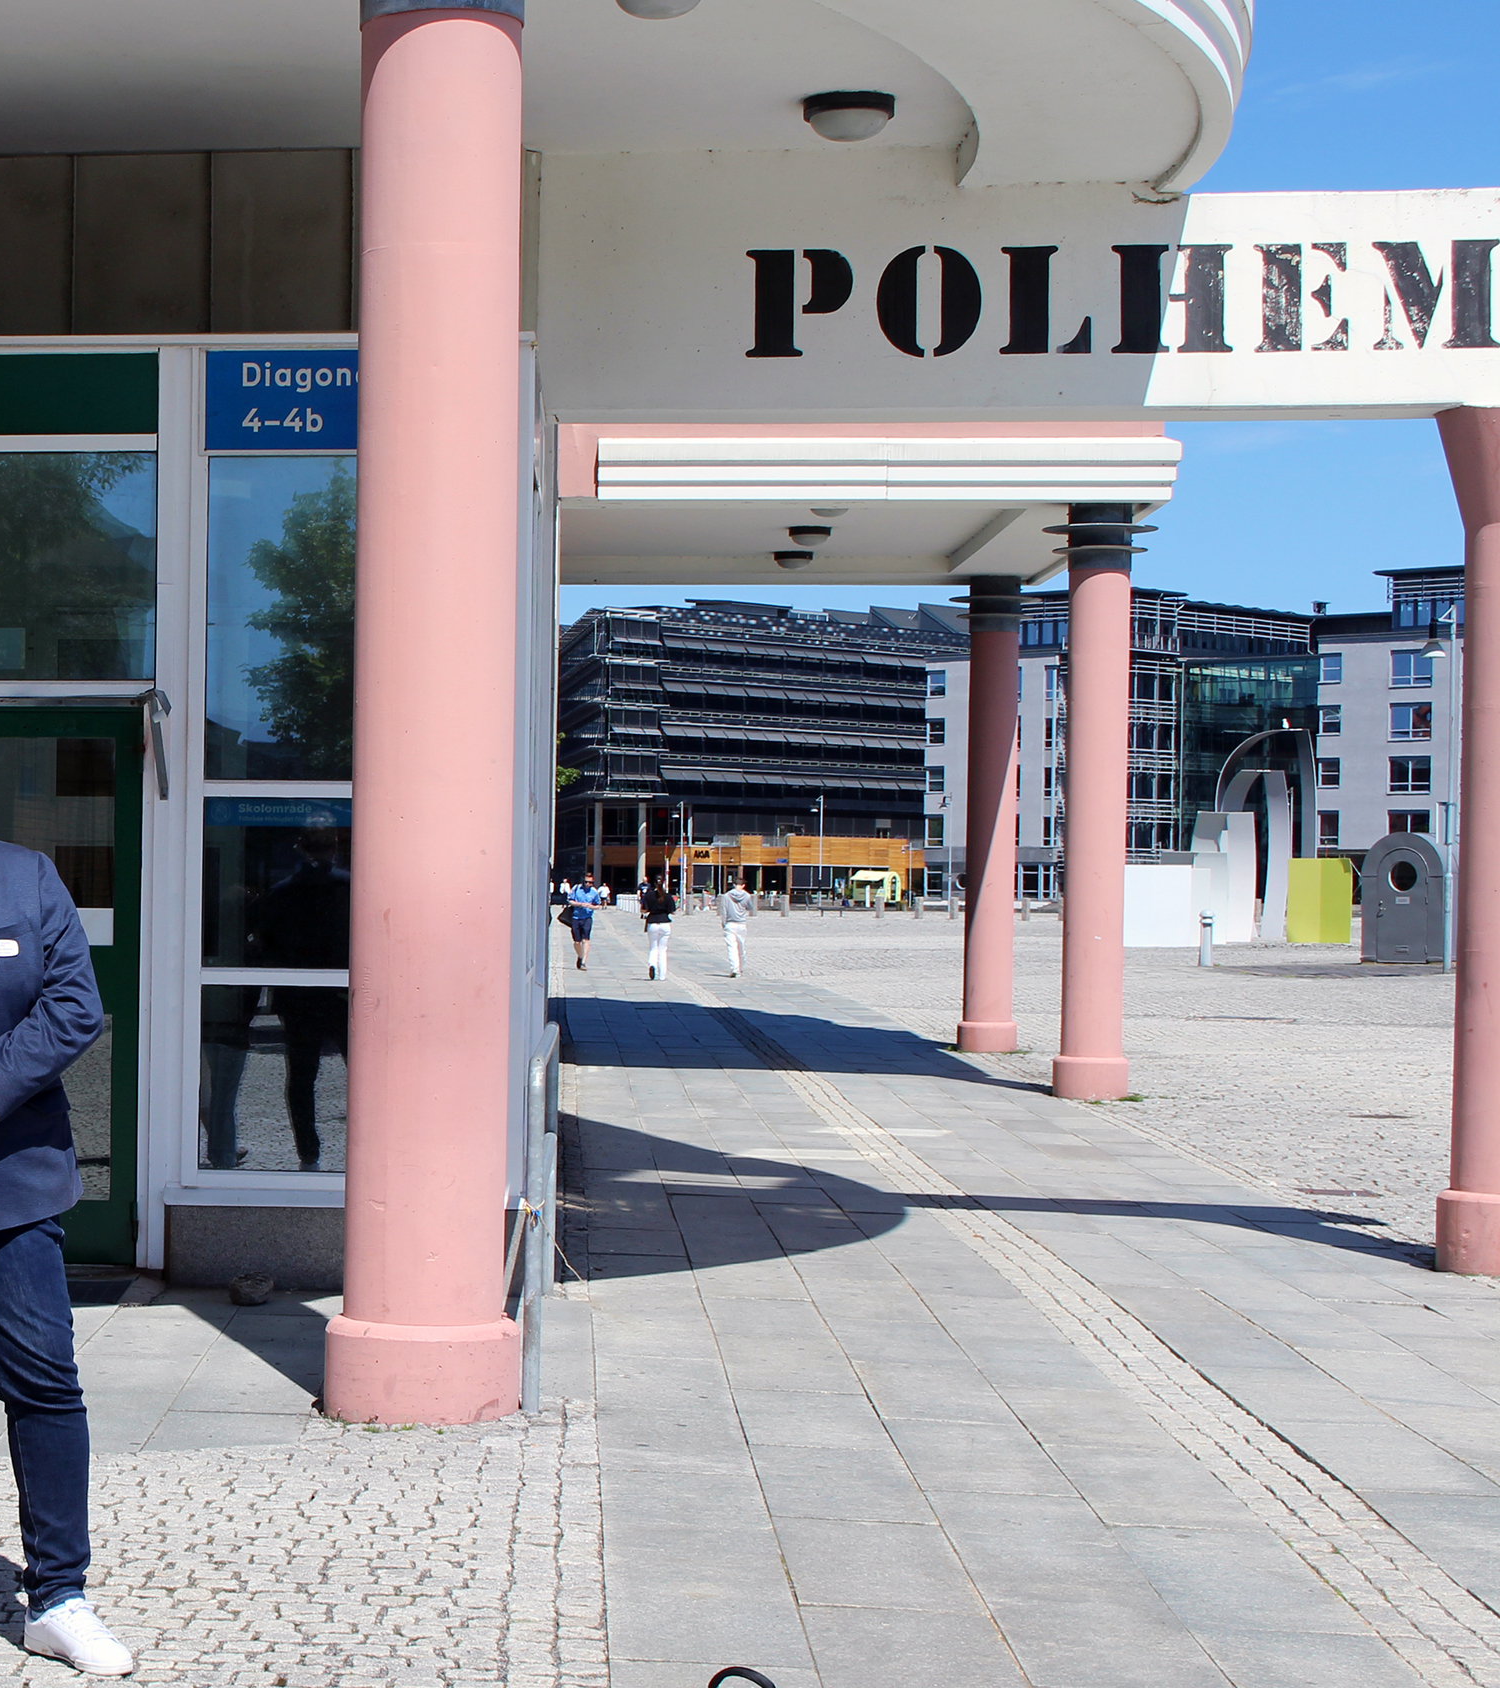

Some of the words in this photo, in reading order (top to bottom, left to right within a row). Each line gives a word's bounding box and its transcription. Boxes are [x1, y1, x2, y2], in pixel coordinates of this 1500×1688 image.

[746, 238, 1500, 358] POLHEM
[242, 361, 359, 393] Diagon
[238, 802, 312, 813] Skolområde
